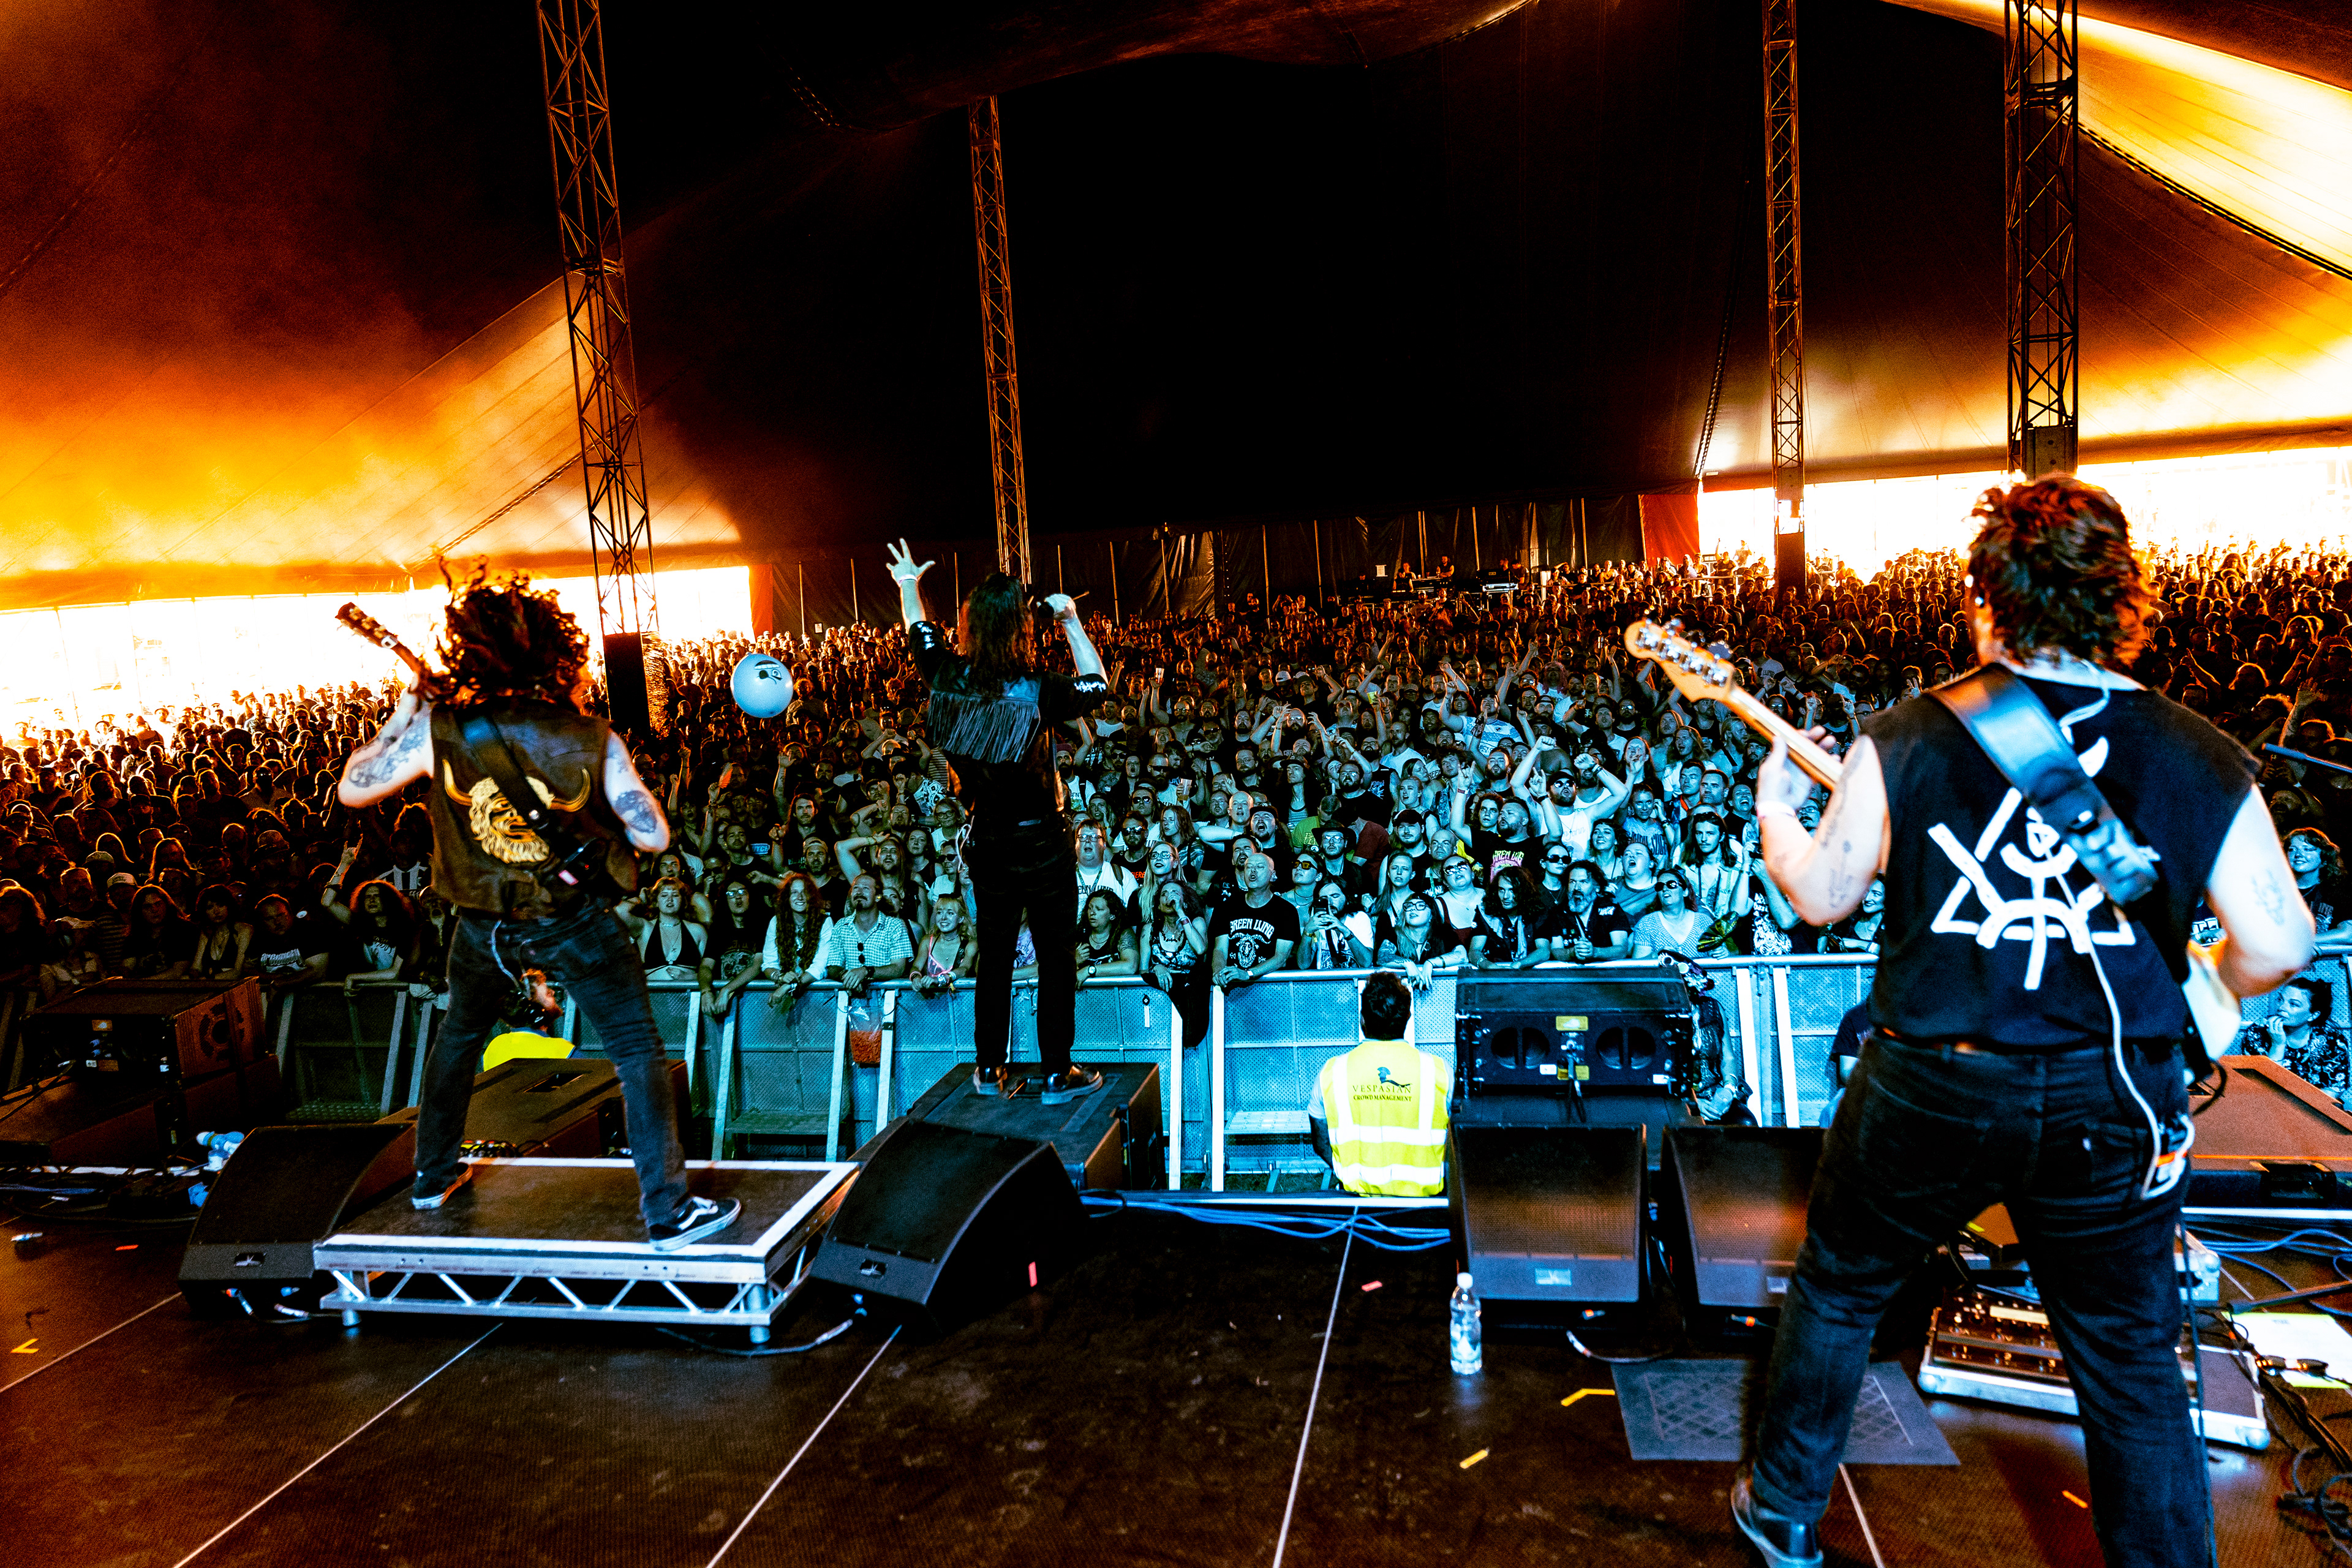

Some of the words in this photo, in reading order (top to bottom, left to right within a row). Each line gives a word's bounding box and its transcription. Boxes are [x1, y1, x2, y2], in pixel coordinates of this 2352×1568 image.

[1493, 850, 1511, 865] GREN
[1230, 918, 1253, 935] GREEN
[1253, 919, 1275, 940] LUNG
[1352, 1084, 1412, 1094] VESPASIAN
